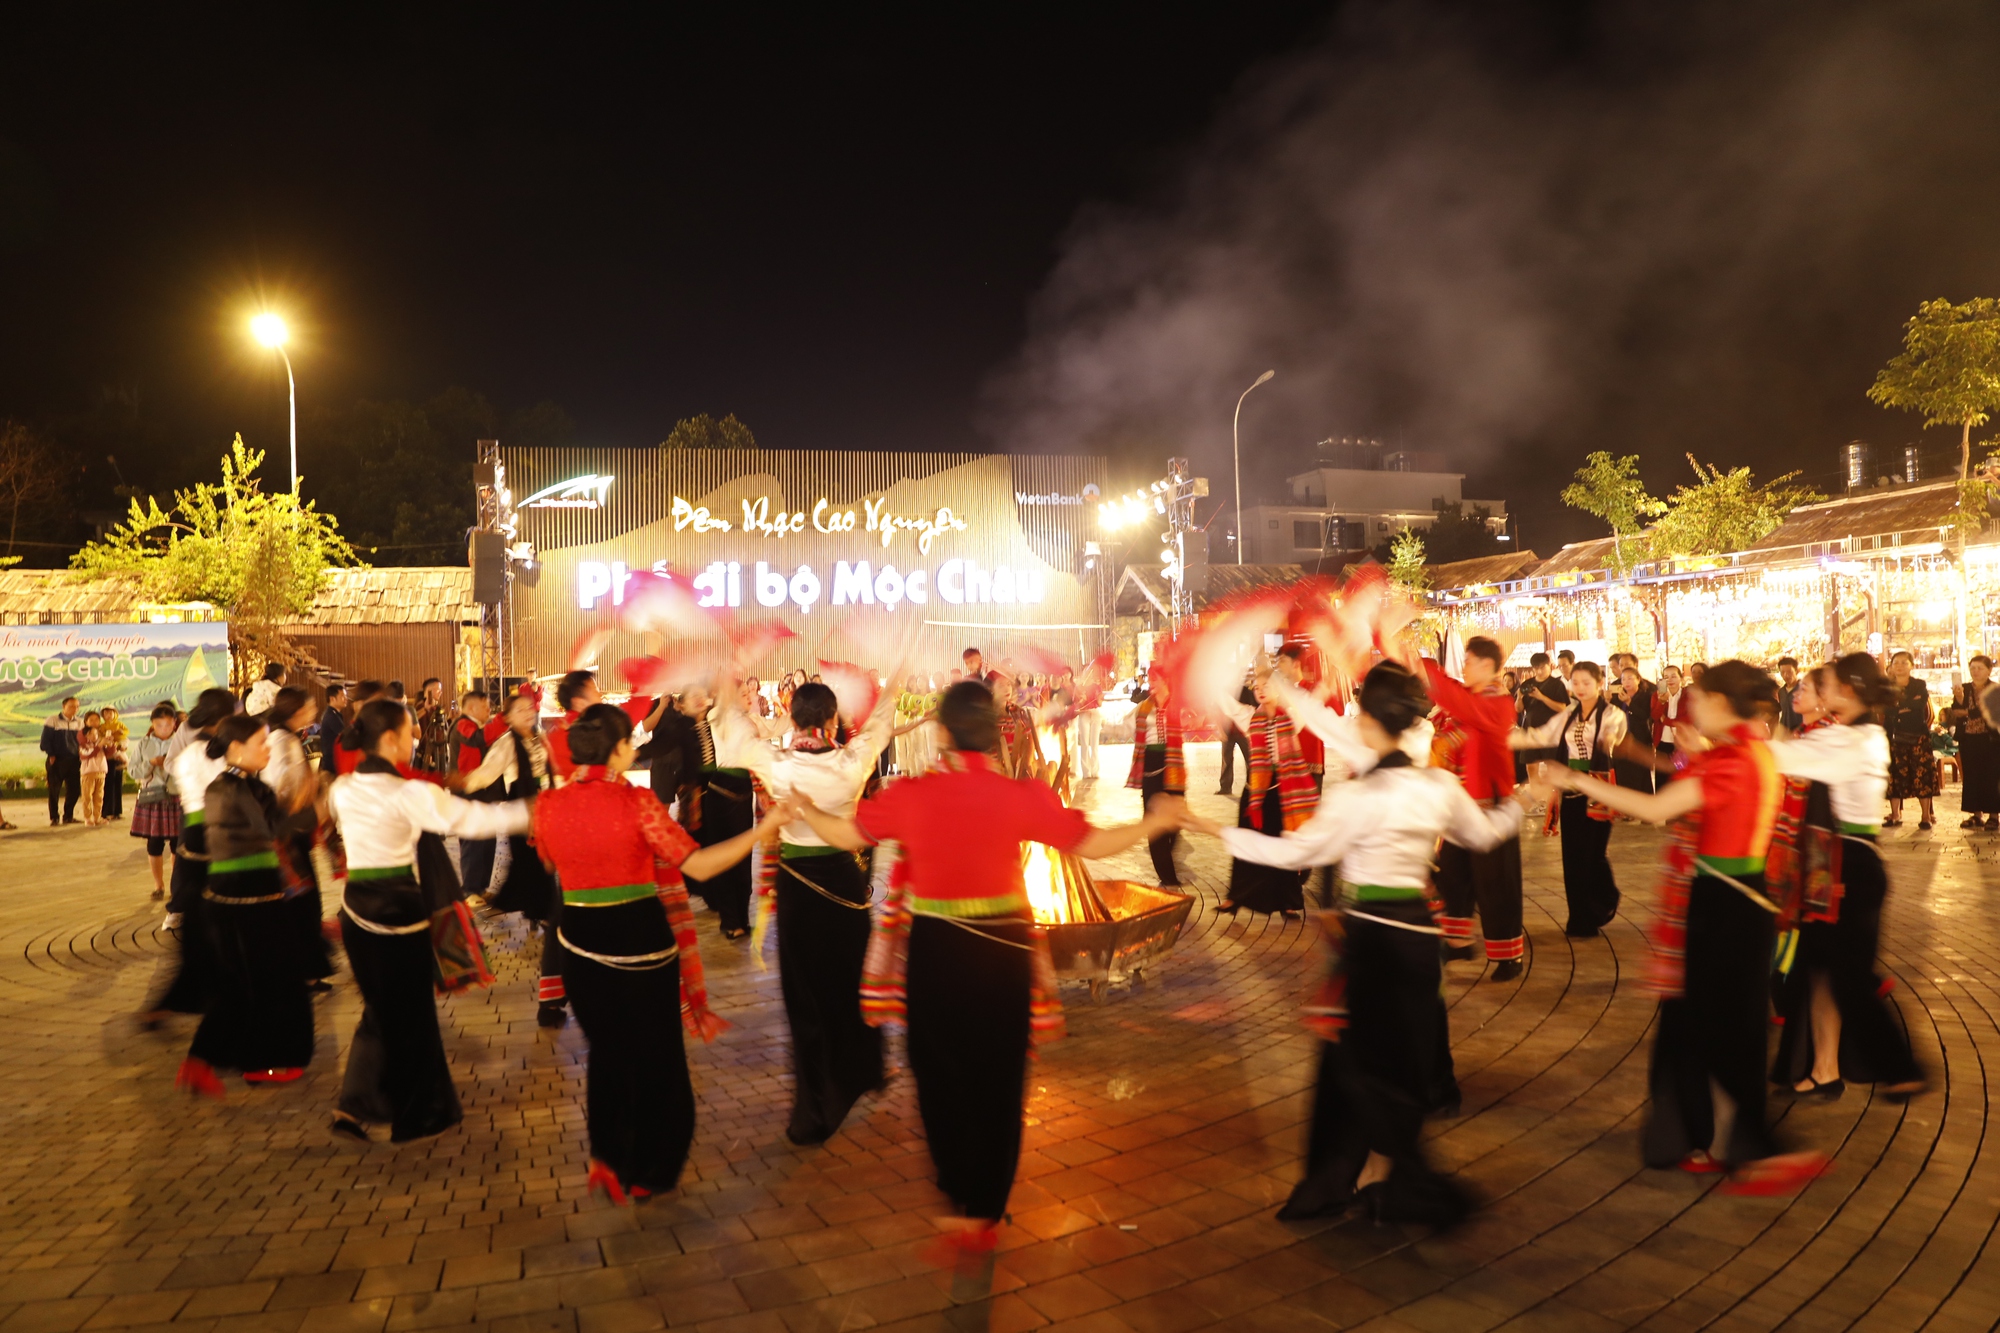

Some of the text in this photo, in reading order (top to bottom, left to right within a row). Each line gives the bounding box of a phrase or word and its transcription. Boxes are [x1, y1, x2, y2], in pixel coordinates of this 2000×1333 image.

[742, 496, 805, 538] Nhạc
[812, 497, 855, 534] Cao
[864, 496, 968, 556] Nguyên
[578, 558, 1044, 614] Ph đi bộ Mộc Châu
[27, 632, 60, 647] màu
[62, 629, 93, 646] Cao
[69, 653, 158, 680] CHÂU
